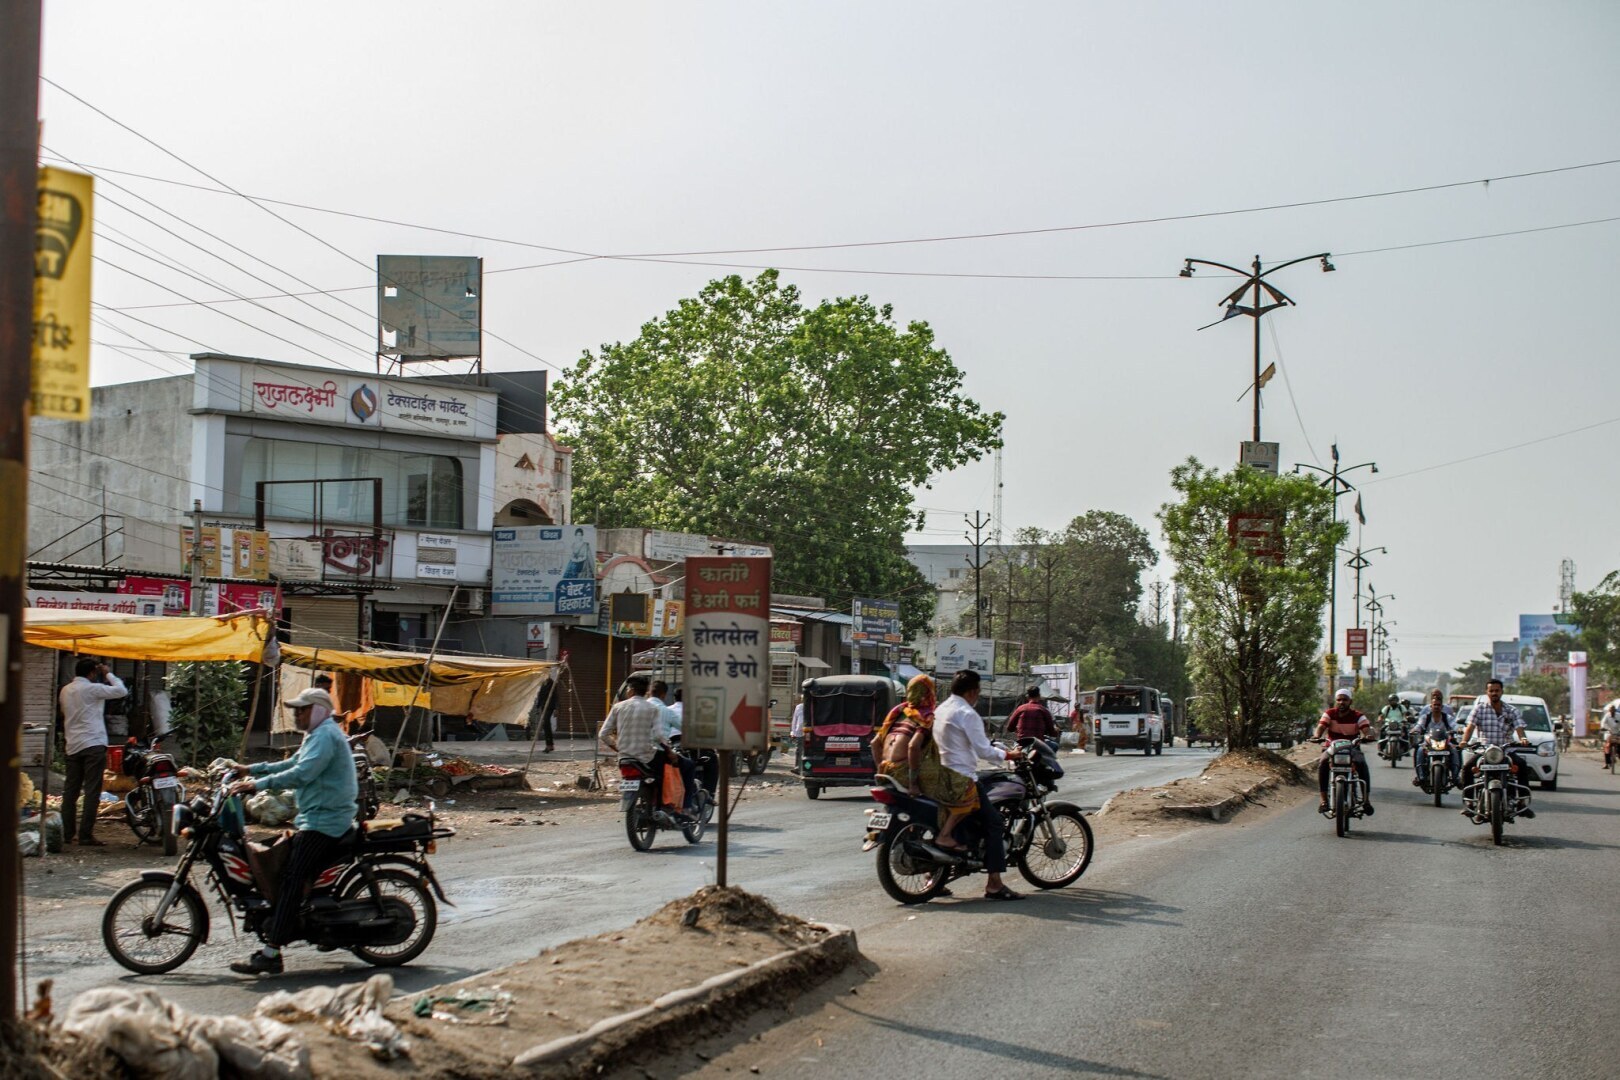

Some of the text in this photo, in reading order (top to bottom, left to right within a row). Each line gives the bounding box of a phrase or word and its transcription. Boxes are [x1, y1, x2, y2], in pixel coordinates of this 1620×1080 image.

[253, 380, 337, 413] राजलक्ष्मी
[387, 389, 436, 412] टेक्सटाईल
[567, 582, 586, 597] बेस्ट
[692, 621, 759, 646] होलसेल
[690, 653, 758, 678] तेल डेपो
